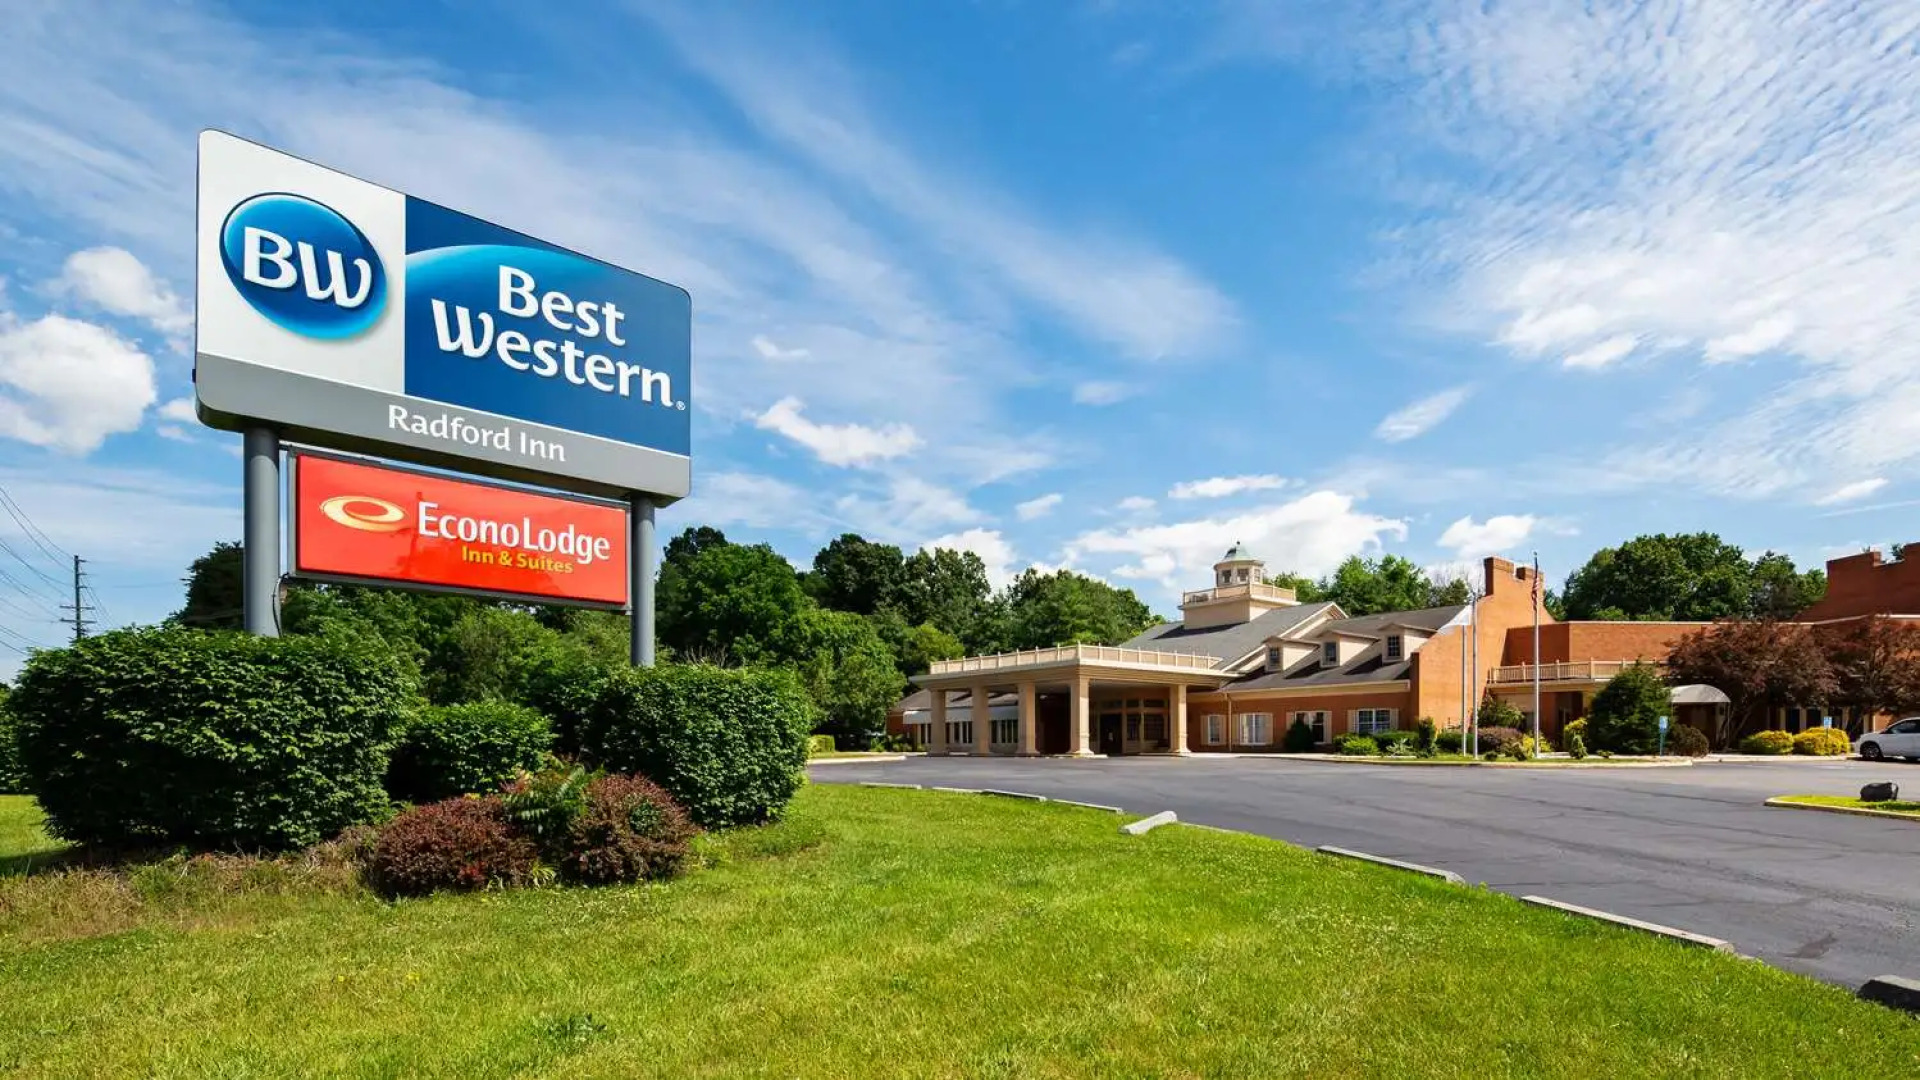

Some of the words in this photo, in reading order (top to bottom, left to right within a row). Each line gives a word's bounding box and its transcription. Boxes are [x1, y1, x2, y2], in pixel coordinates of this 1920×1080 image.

[242, 226, 372, 308] BW
[499, 265, 625, 346] Best
[388, 404, 510, 451] Radford
[520, 431, 566, 462] Inn
[462, 546, 494, 565] Inn
[499, 551, 512, 566] &
[516, 553, 574, 573] Suites
